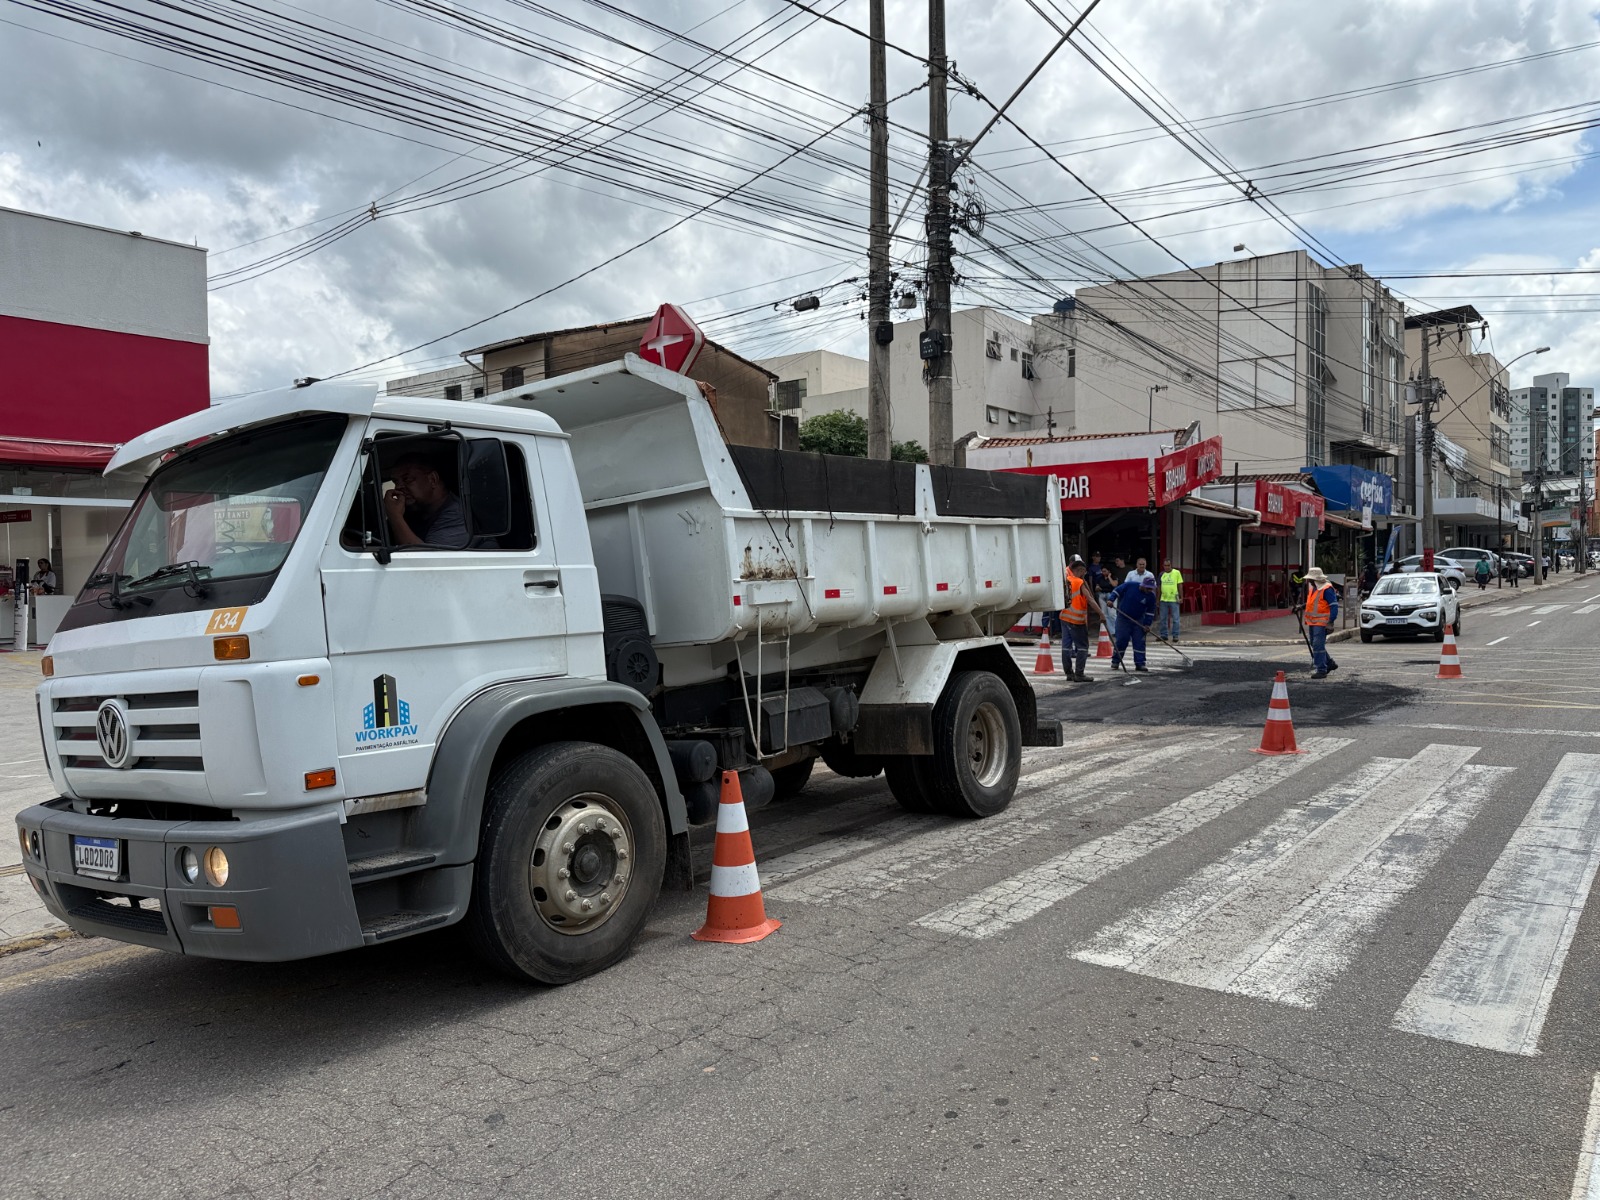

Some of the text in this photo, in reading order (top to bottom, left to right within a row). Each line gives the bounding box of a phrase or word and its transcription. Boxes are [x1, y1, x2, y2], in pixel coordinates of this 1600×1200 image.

[1058, 475, 1090, 499] BAR
[1165, 465, 1187, 492] BRAHMA
[213, 611, 240, 630] 134
[355, 724, 418, 742] WORKPAV
[355, 738, 419, 752] PAVIMENTAÇÃO ASFÁLTICA
